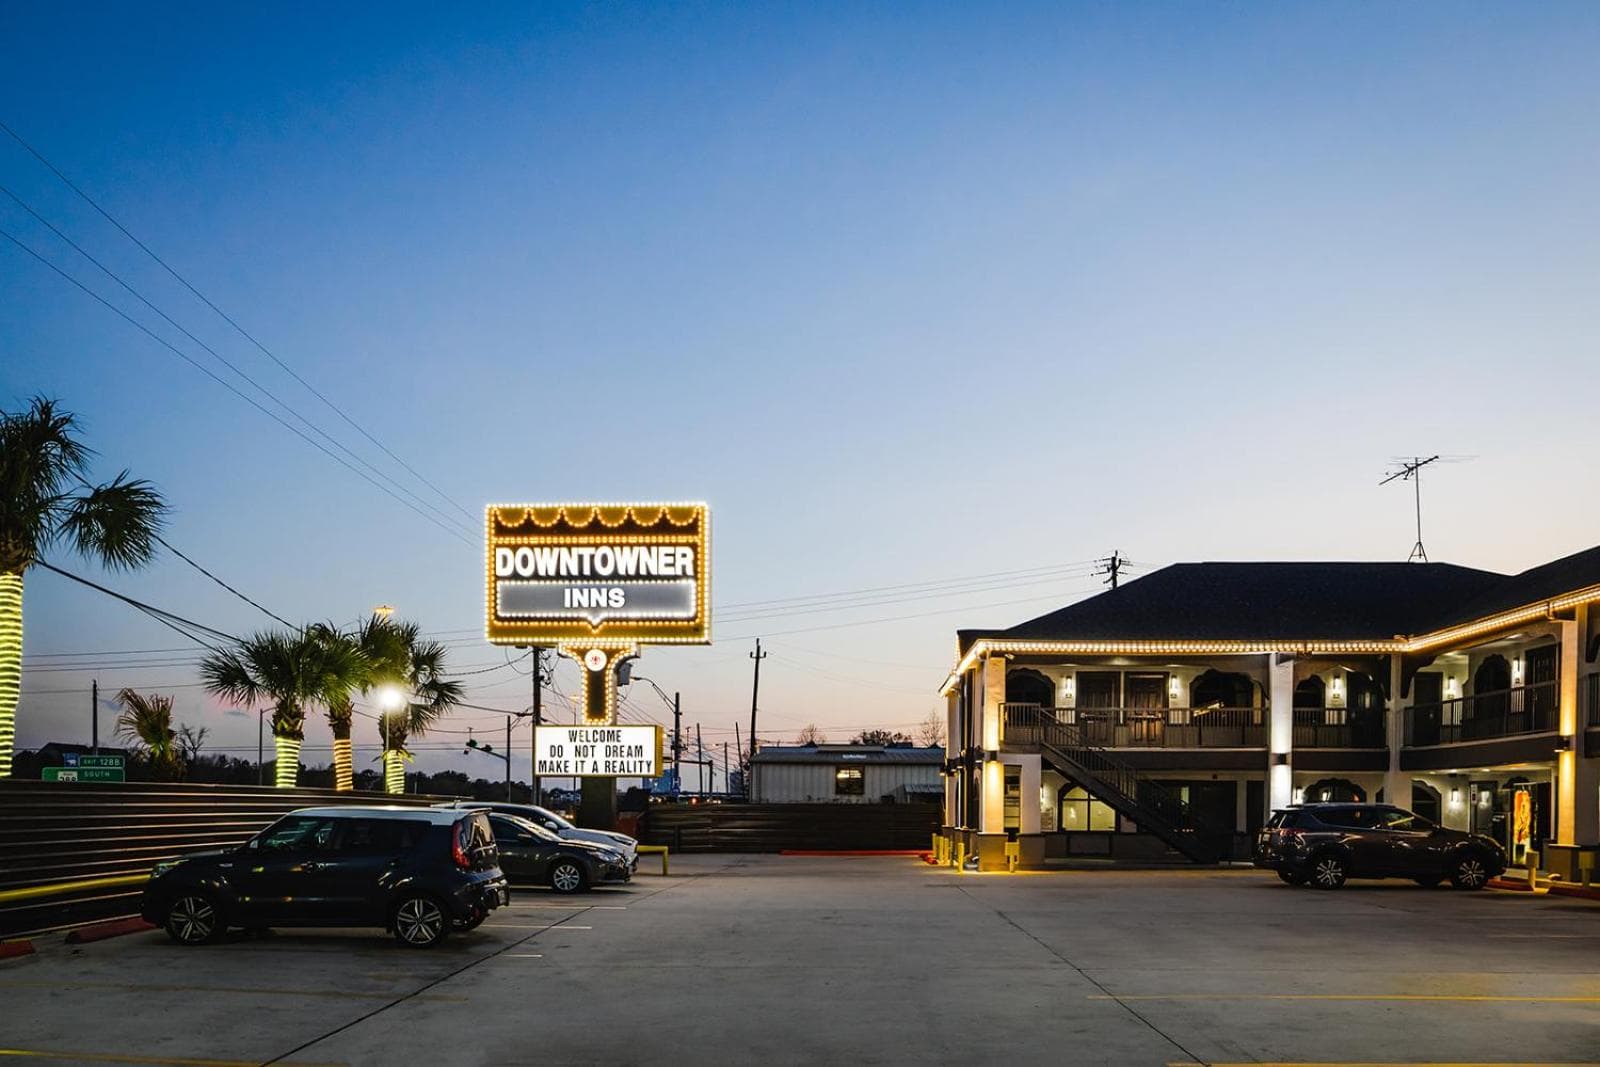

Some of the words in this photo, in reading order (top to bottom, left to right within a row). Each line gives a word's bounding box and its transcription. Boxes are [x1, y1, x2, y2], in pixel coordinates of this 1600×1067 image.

[495, 546, 694, 577] DOWNTOWNER
[564, 588, 625, 608] INNS
[568, 730, 621, 742] WELCOME
[550, 745, 563, 758] DO
[574, 745, 595, 758] NOT
[605, 745, 643, 758] DREAM
[539, 760, 569, 773] MAKE
[575, 760, 585, 773] IT
[592, 760, 599, 773] A
[604, 760, 652, 773] REALITY
